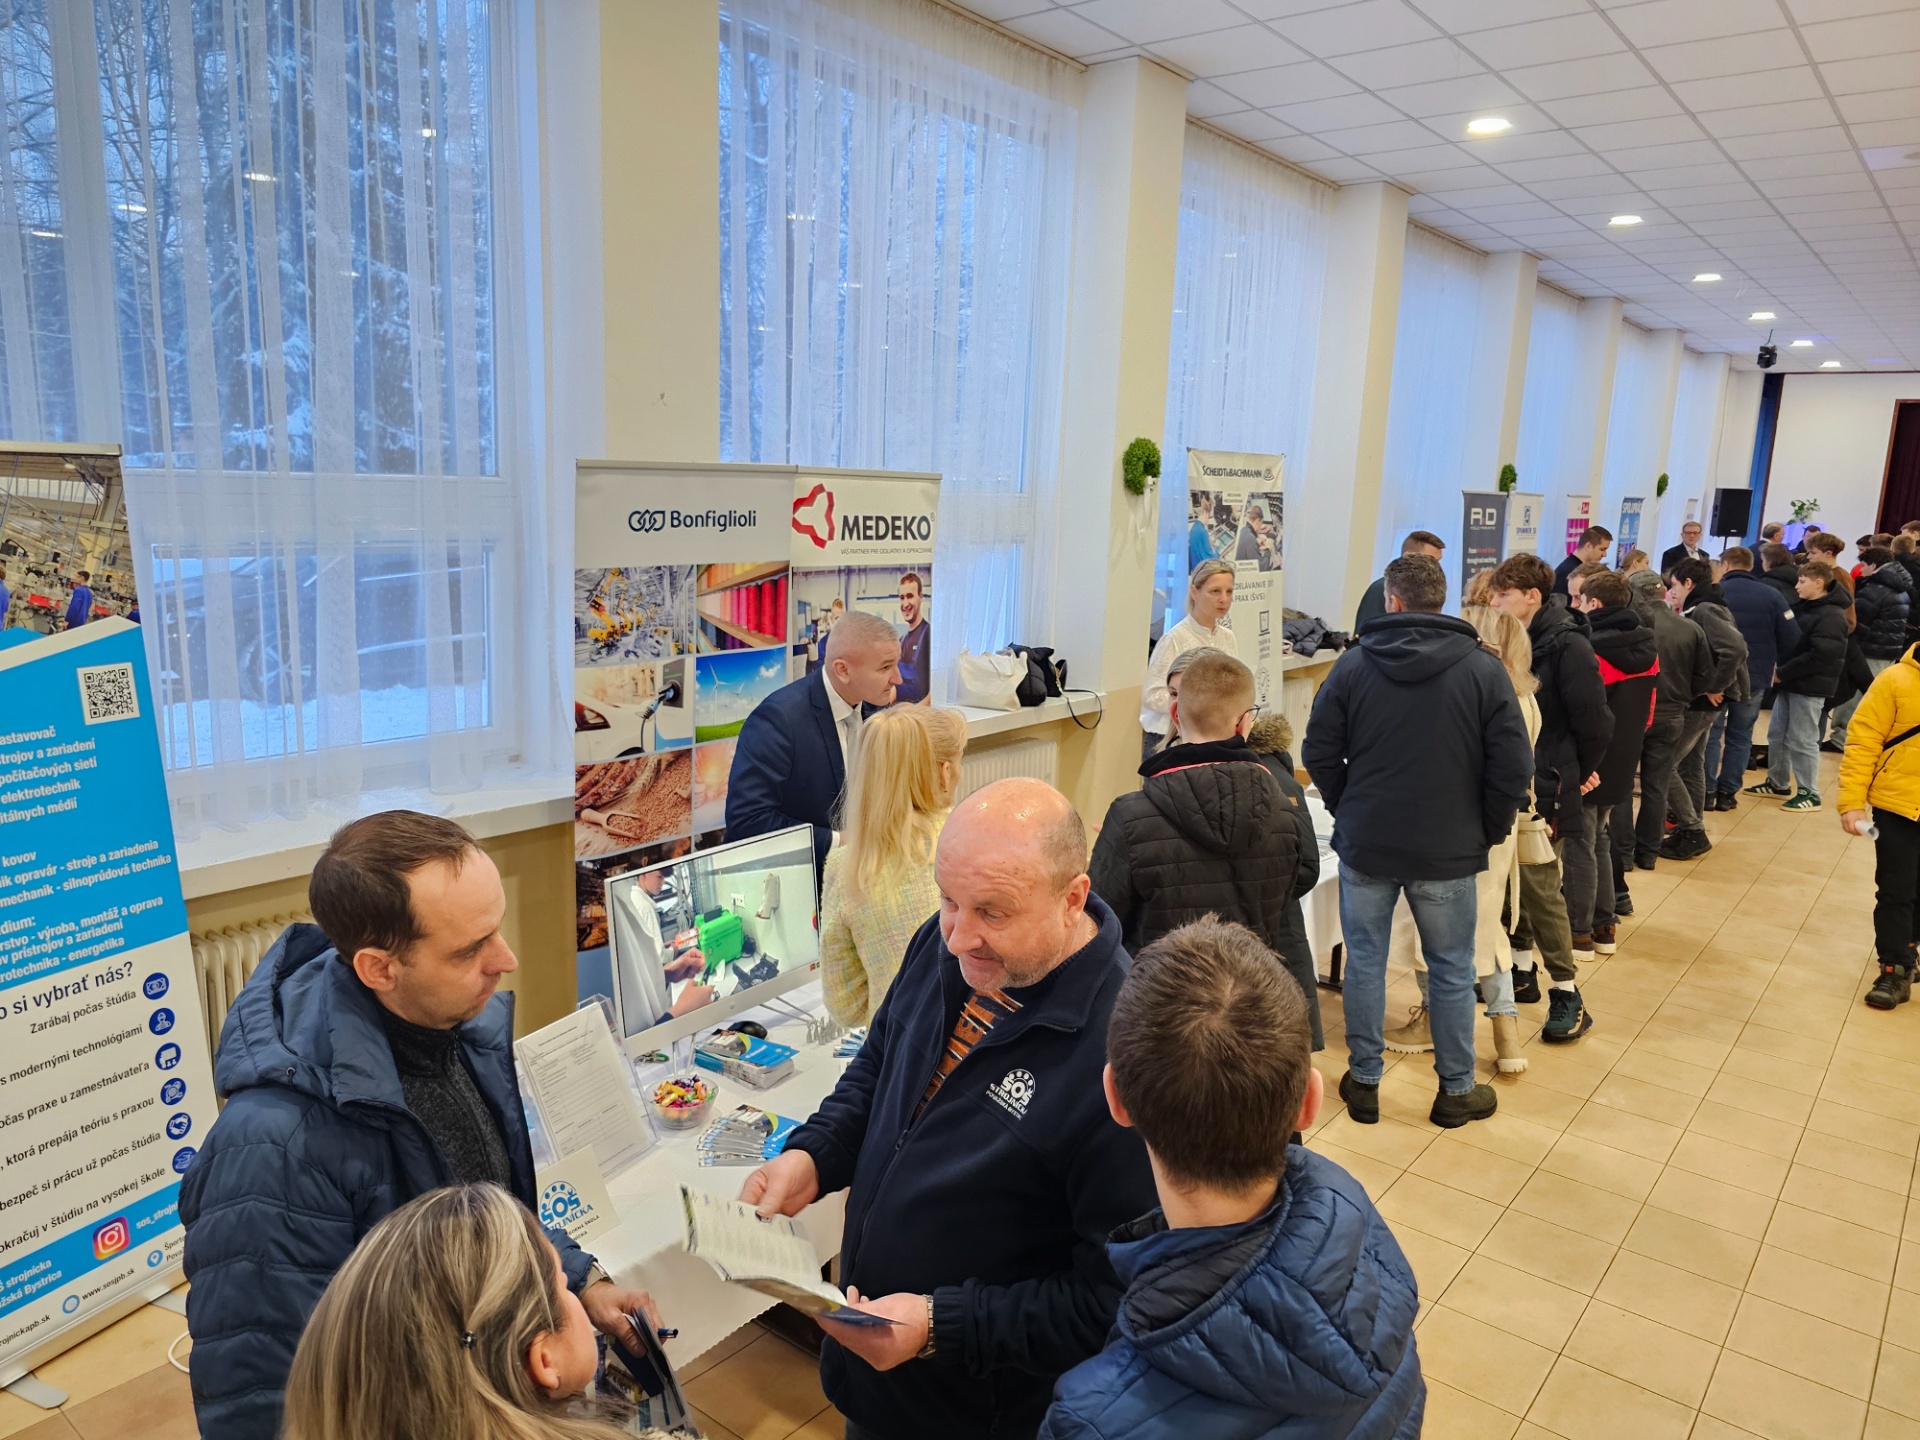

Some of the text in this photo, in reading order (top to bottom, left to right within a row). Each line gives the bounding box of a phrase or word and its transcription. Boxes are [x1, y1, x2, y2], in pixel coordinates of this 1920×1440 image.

[670, 510, 756, 532] Bonfiglioli
[841, 515, 931, 541] MEDEKO
[0, 737, 96, 765] trojov a zariadení
[1, 778, 81, 804] elektrotechnik
[0, 884, 54, 908] mechanik
[63, 866, 130, 891] silnoprúdová
[132, 854, 172, 873] technika
[2, 851, 37, 867] kovov
[14, 864, 57, 885] opravár
[66, 855, 97, 871] stroje
[108, 840, 159, 860] zariadenia
[0, 916, 36, 935] dium:
[11, 939, 63, 964] prístrojov
[75, 918, 124, 943] zariadení
[37, 921, 79, 941] výroba,
[80, 906, 120, 928] montáž
[130, 896, 163, 915] oprava
[0, 955, 60, 983] rotechnika
[68, 936, 125, 961] energetika
[13, 995, 28, 1015] si
[32, 974, 89, 1009] vybrať
[95, 961, 133, 987] nás?
[30, 990, 137, 1034] Zarábaj počas štúdia
[9, 1051, 70, 1082] modernými
[72, 1024, 143, 1058] technológiami
[27, 1098, 58, 1119] praxe
[69, 1062, 150, 1101] zamestnávateľa
[6, 1145, 36, 1167] ktorá
[38, 1129, 78, 1155] prepája
[80, 1115, 111, 1134] teóriu
[121, 1097, 155, 1119] praxou
[41, 1180, 51, 1192] si
[53, 1166, 83, 1188] prácu
[86, 1158, 98, 1172] už
[100, 1146, 130, 1168] počas
[132, 1131, 161, 1151] štúdia
[42, 1223, 49, 1232] v
[51, 1205, 84, 1228] štúdiu
[86, 1200, 99, 1212] na
[101, 1180, 139, 1204] vysokej
[140, 1167, 166, 1186] škole
[24, 1270, 62, 1297] Bystrica
